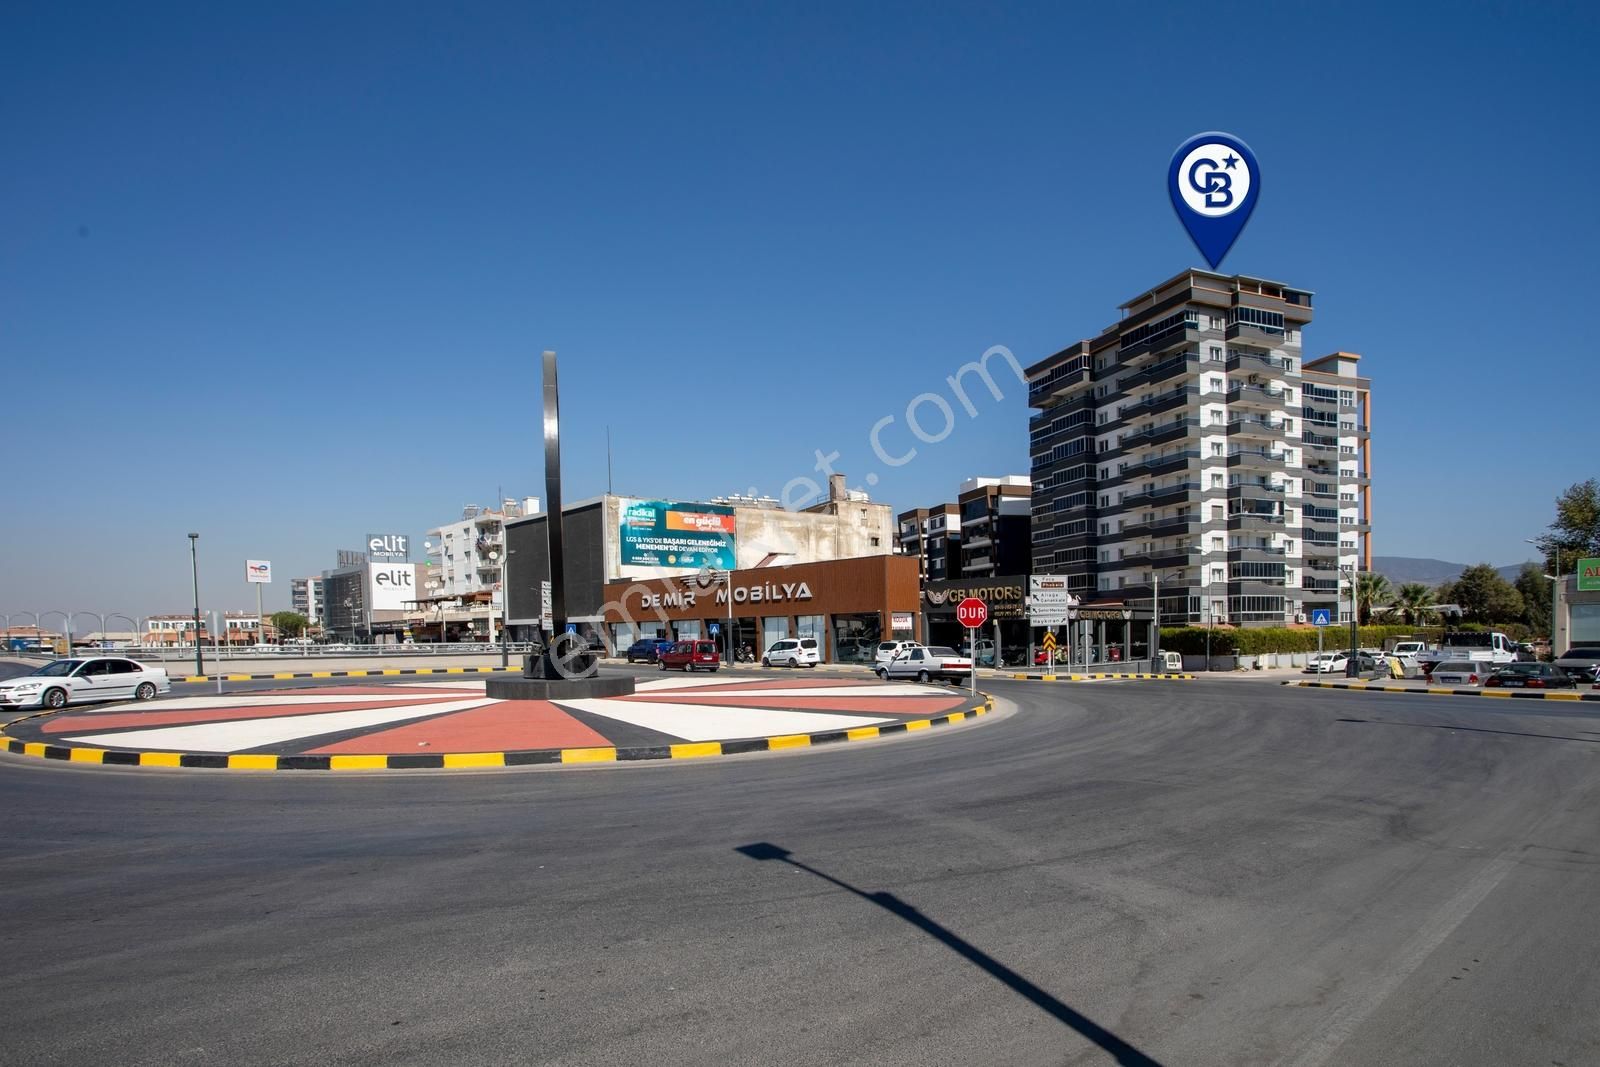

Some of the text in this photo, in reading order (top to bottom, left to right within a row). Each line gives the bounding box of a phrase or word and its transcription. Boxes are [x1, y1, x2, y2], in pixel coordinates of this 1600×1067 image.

[628, 508, 656, 518] radikal
[683, 516, 721, 528] en güçlü
[370, 535, 406, 552] elit
[636, 543, 678, 552] MENEMEN'DE
[699, 546, 719, 554] EDİYOR
[663, 538, 687, 546] BAŞARI
[687, 539, 726, 548] GELENEĞİMİZ
[375, 569, 411, 586] elit
[641, 581, 813, 609] DEMİR MOBİLYA
[950, 585, 1023, 603] GB MOTORS
[959, 607, 985, 619] DUR
